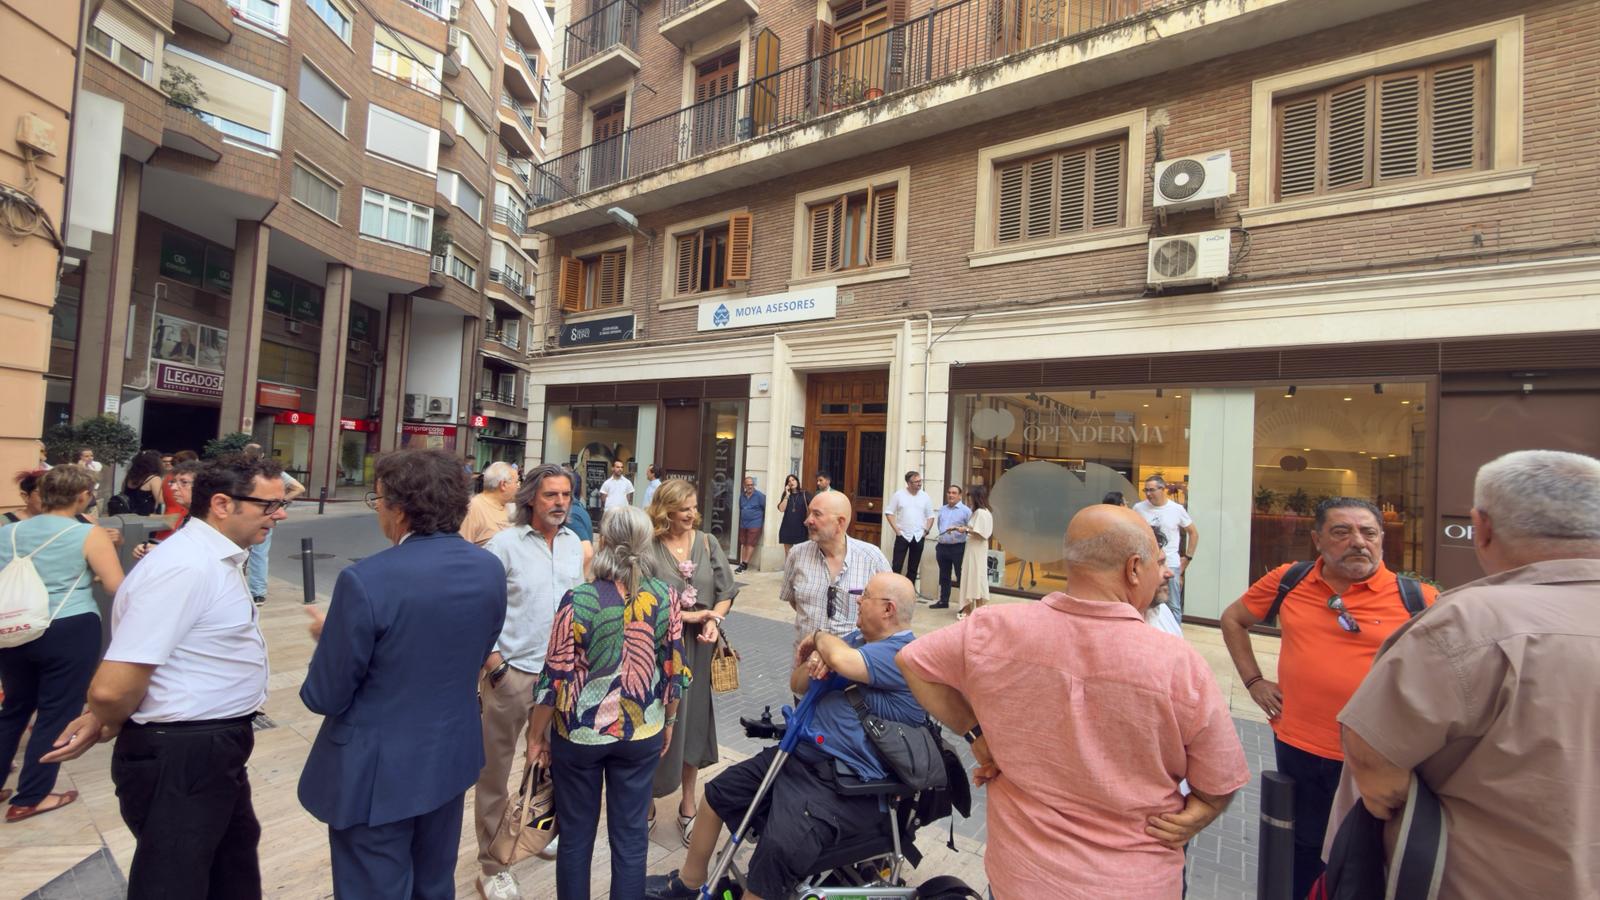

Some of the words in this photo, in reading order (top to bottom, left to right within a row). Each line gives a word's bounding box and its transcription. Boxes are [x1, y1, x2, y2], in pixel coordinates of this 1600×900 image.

[735, 305, 763, 318] MOYA
[766, 298, 815, 314] ASESORES
[167, 369, 218, 388] LEGADOS
[1024, 426, 1163, 443] OPENDERMA
